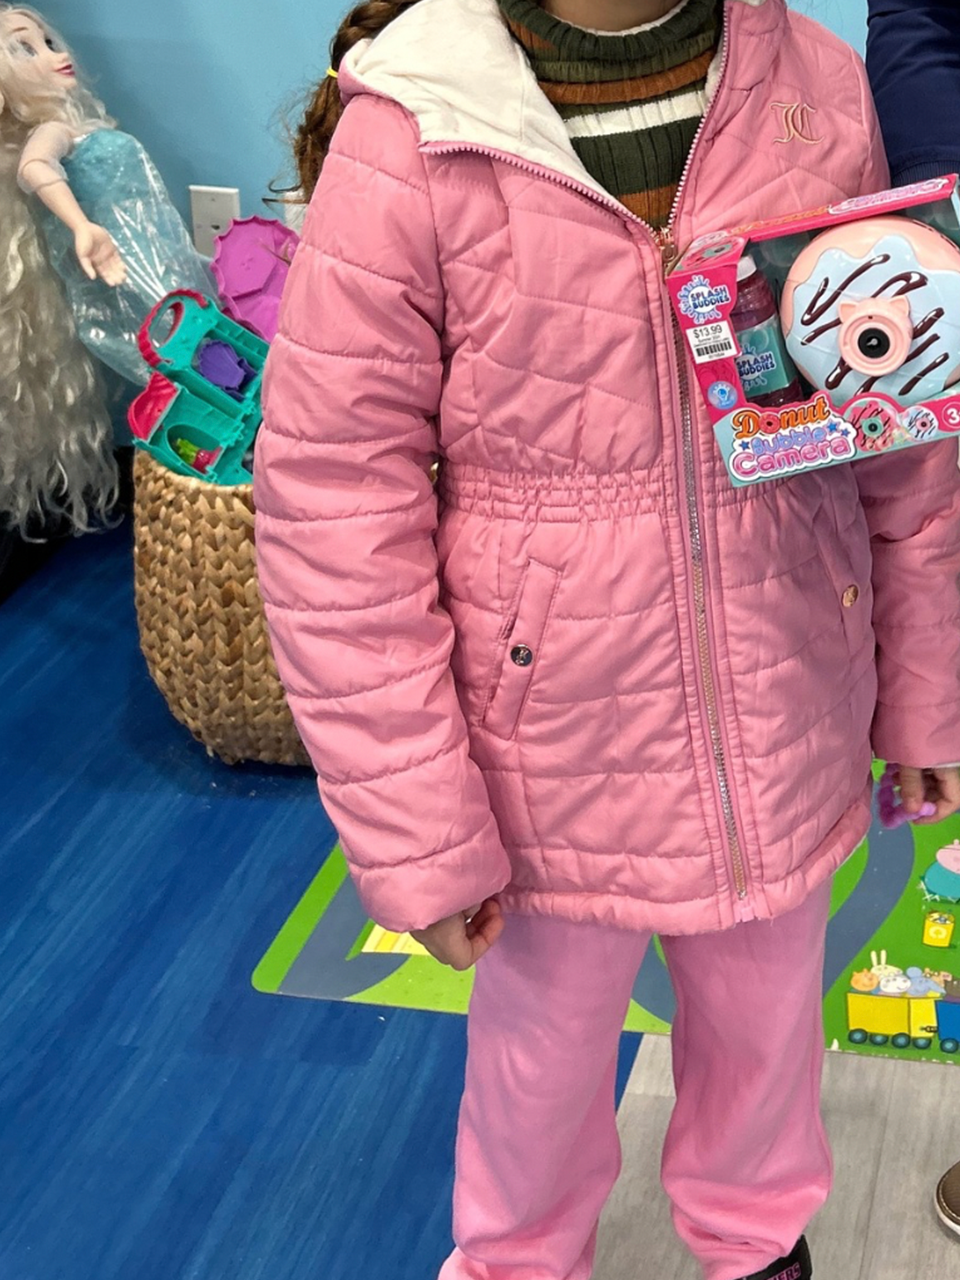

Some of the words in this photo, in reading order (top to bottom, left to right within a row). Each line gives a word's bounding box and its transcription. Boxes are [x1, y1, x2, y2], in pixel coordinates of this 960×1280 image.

[690, 286, 728, 302] SPLASH
[692, 296, 730, 309] BUDDIES
[693, 324, 722, 339] $13.99
[732, 396, 831, 439] Donut
[750, 426, 827, 455] Bubble
[733, 437, 851, 478] Camera
